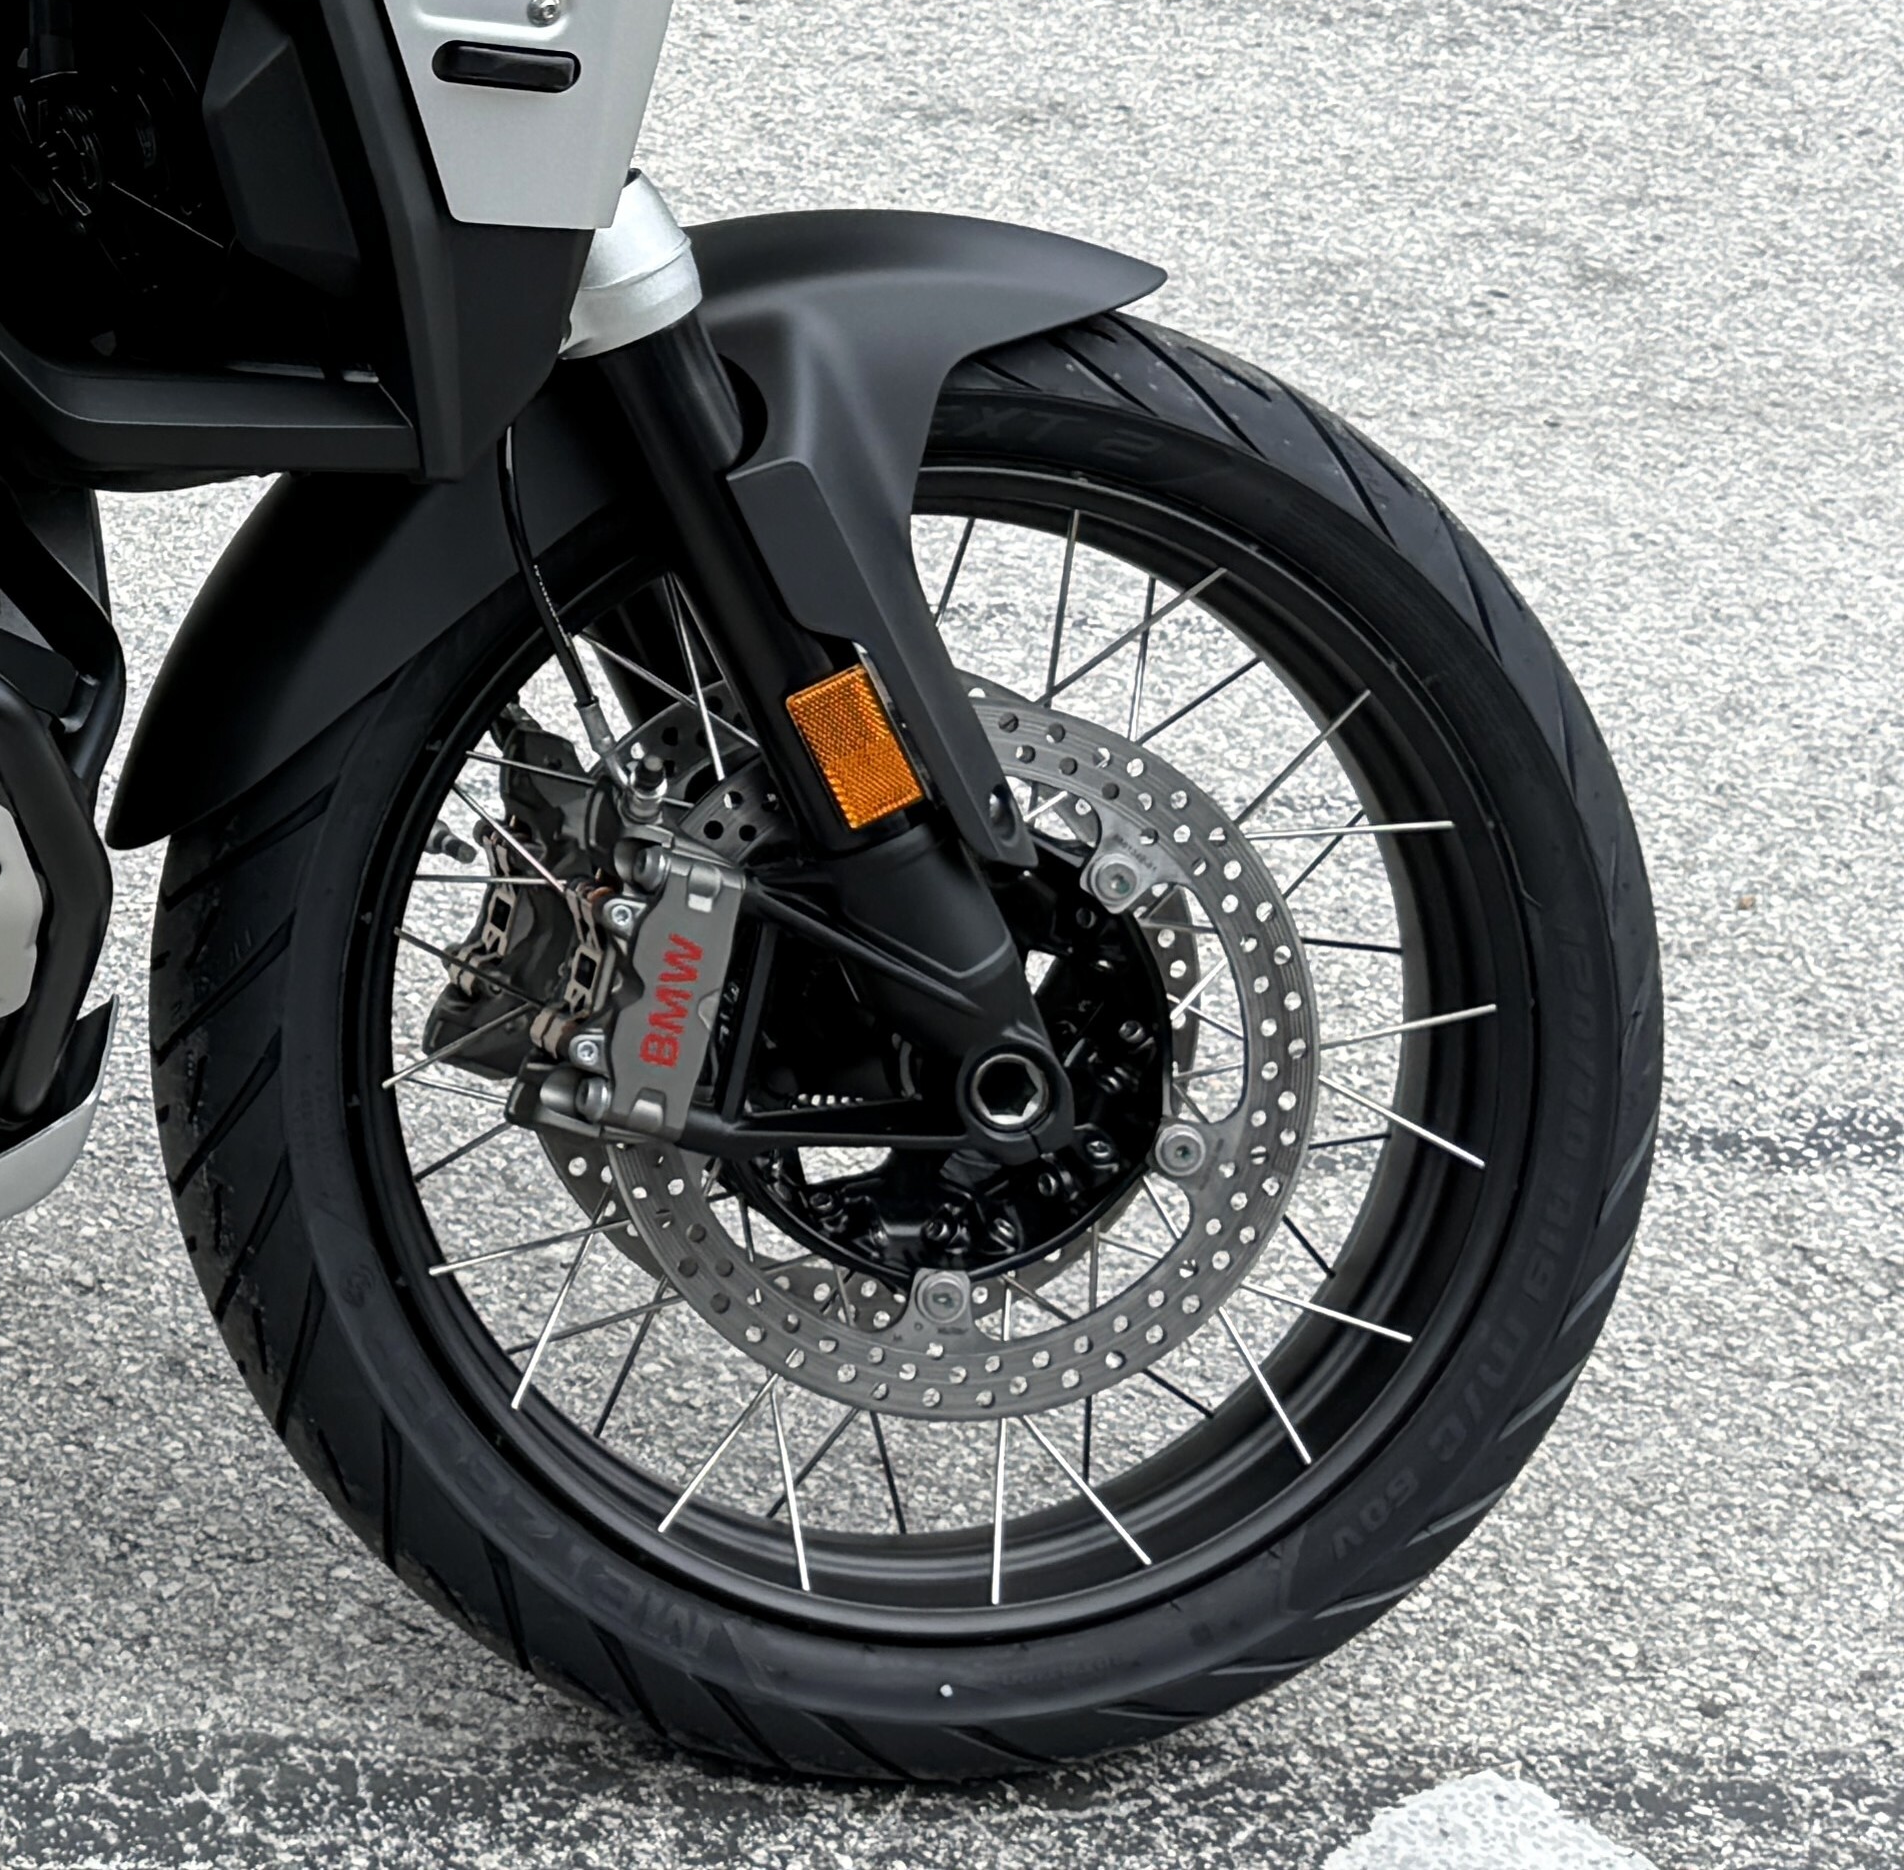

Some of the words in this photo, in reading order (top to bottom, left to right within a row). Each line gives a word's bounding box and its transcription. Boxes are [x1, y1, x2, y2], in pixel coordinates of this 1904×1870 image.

[639, 932, 705, 1070] BMW
[1556, 919, 1596, 1156] 120/70
[1525, 1178, 1578, 1304] R19
[1427, 1318, 1530, 1461] M/C
[1328, 1473, 1420, 1561] 60V
